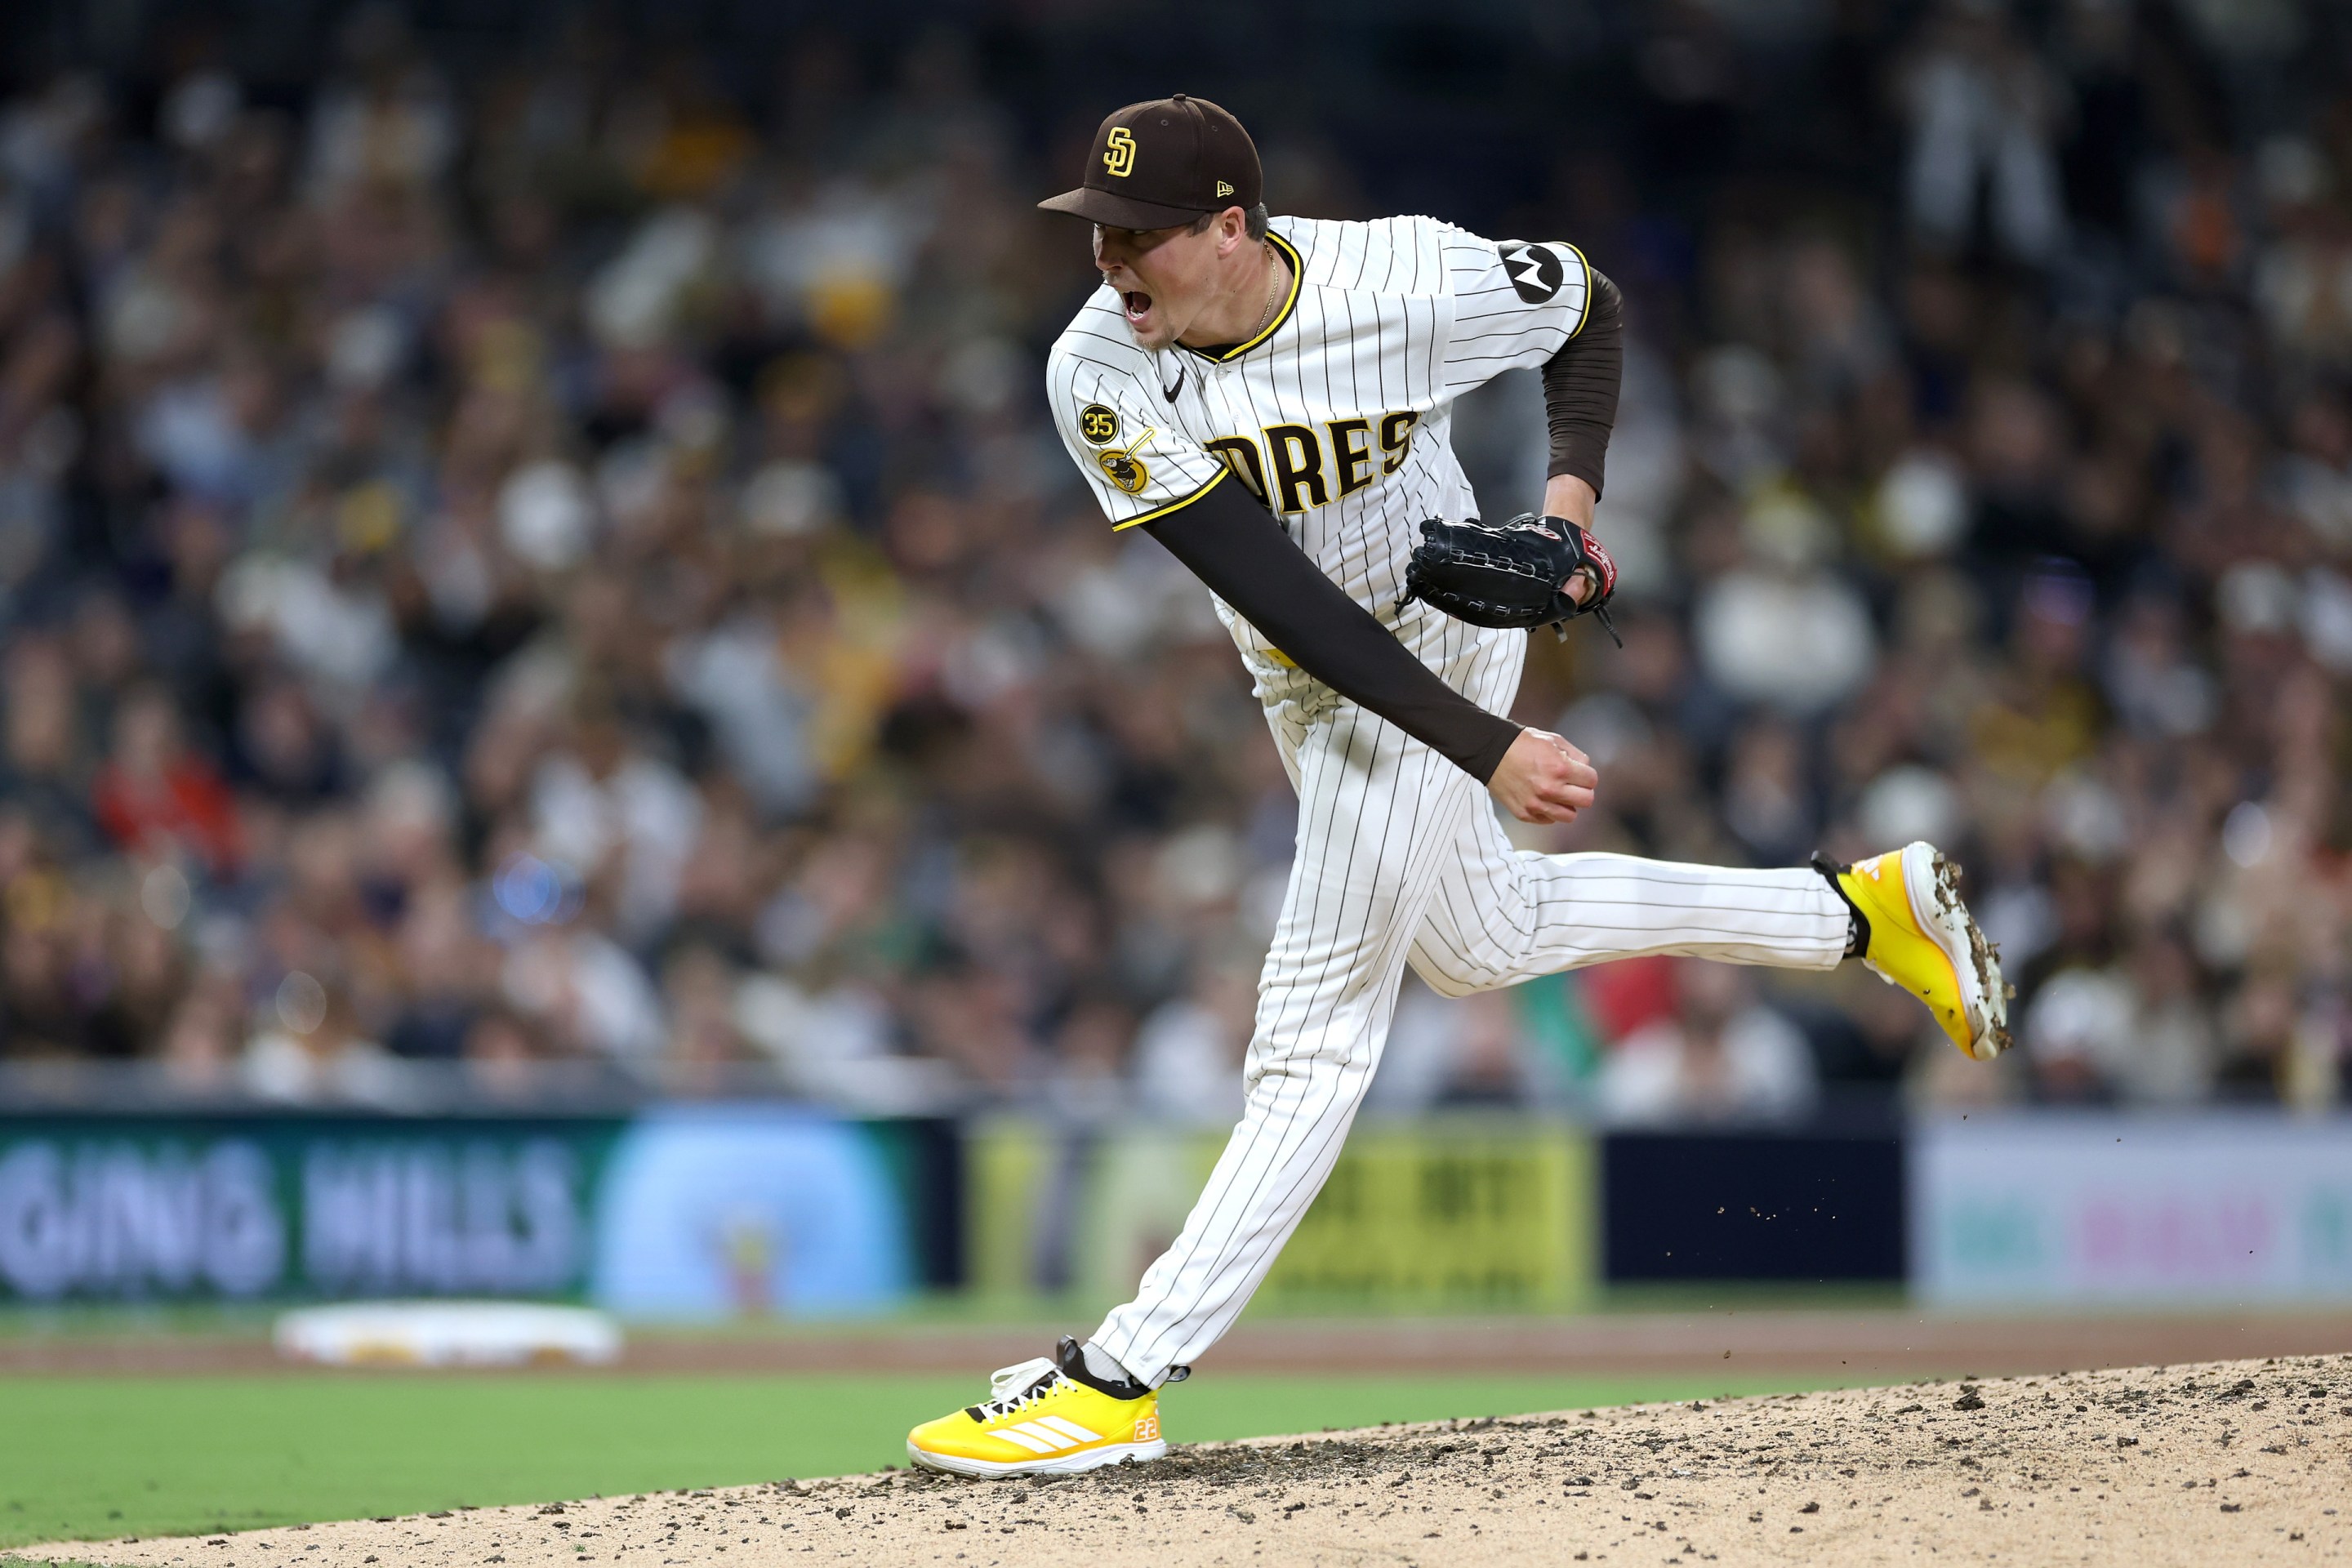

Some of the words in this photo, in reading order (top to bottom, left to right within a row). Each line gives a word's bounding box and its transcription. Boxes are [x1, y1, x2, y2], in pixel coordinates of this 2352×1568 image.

[1103, 127, 1136, 177] SD
[1085, 412, 1113, 436] 35
[1203, 411, 1419, 514] DRES
[1134, 1417, 1157, 1441] 22
